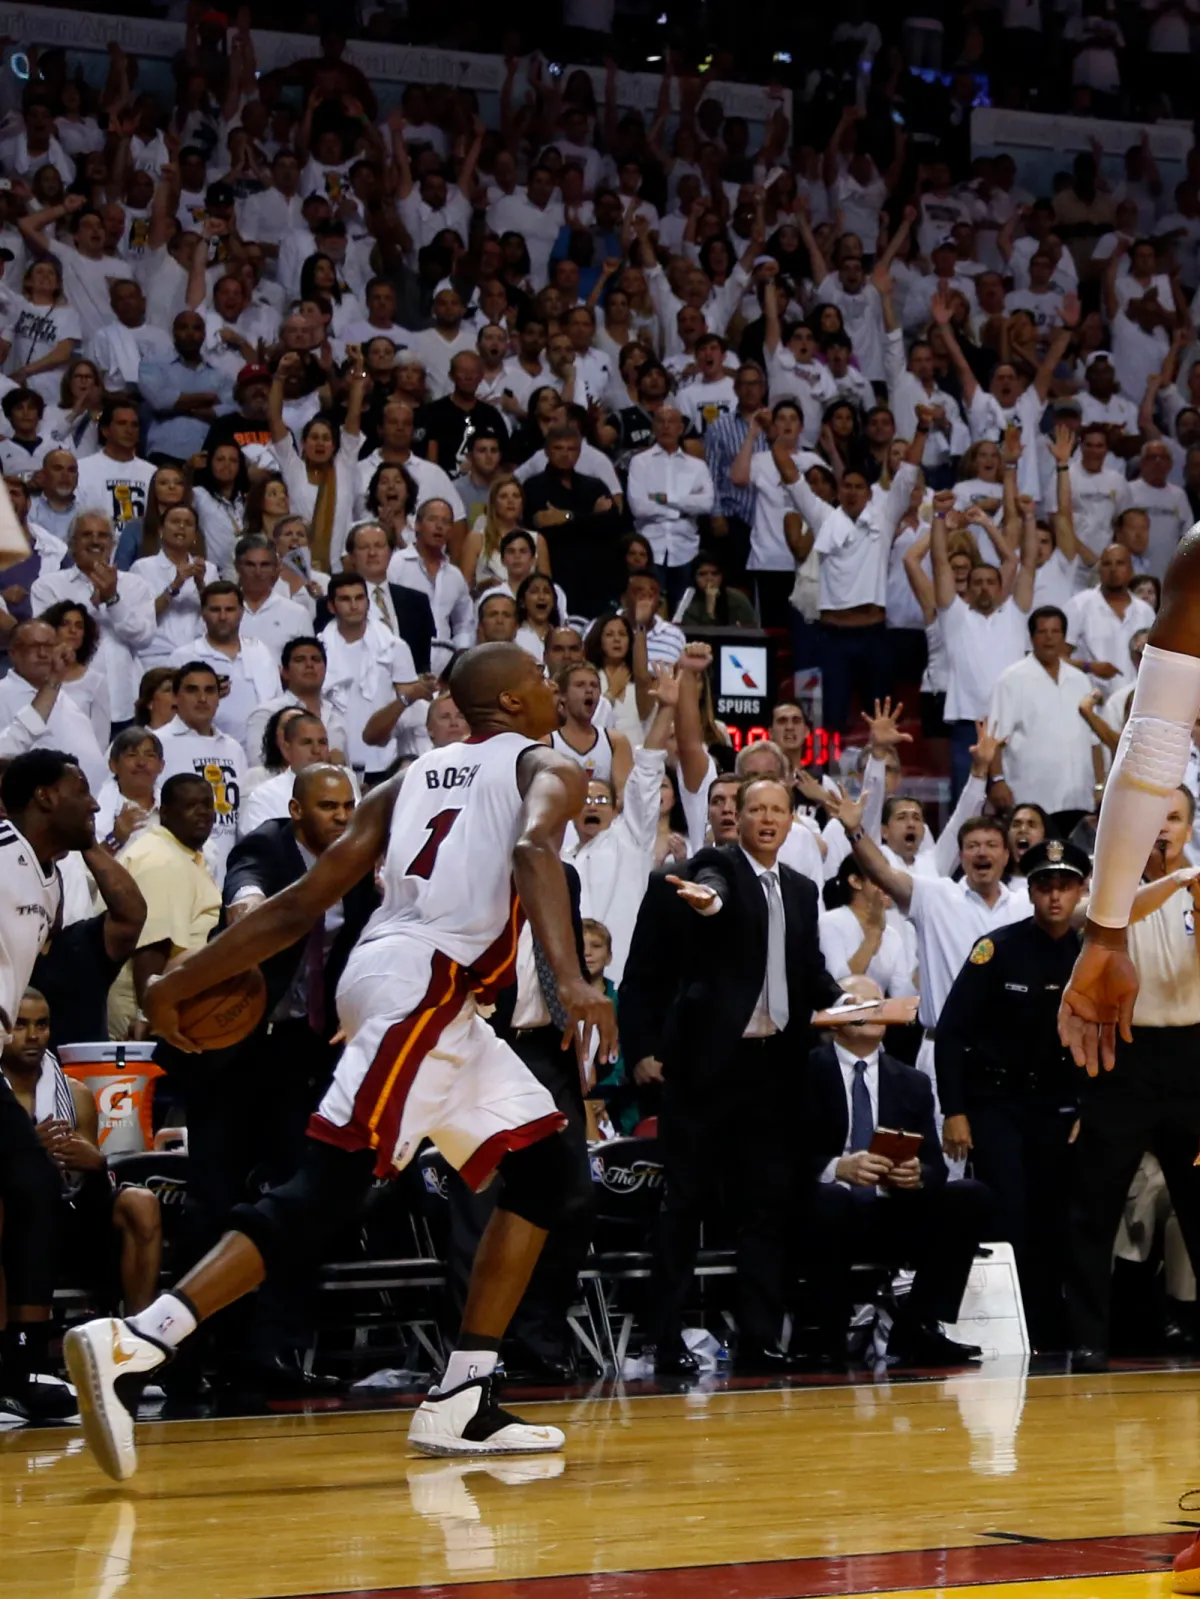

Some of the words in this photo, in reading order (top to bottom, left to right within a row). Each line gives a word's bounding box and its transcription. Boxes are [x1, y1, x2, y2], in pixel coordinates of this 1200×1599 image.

[717, 698, 760, 714] SPURS
[425, 764, 482, 789] BOSH
[404, 807, 464, 881] 1
[100, 1083, 133, 1119] G
[605, 1166, 636, 1186] The
